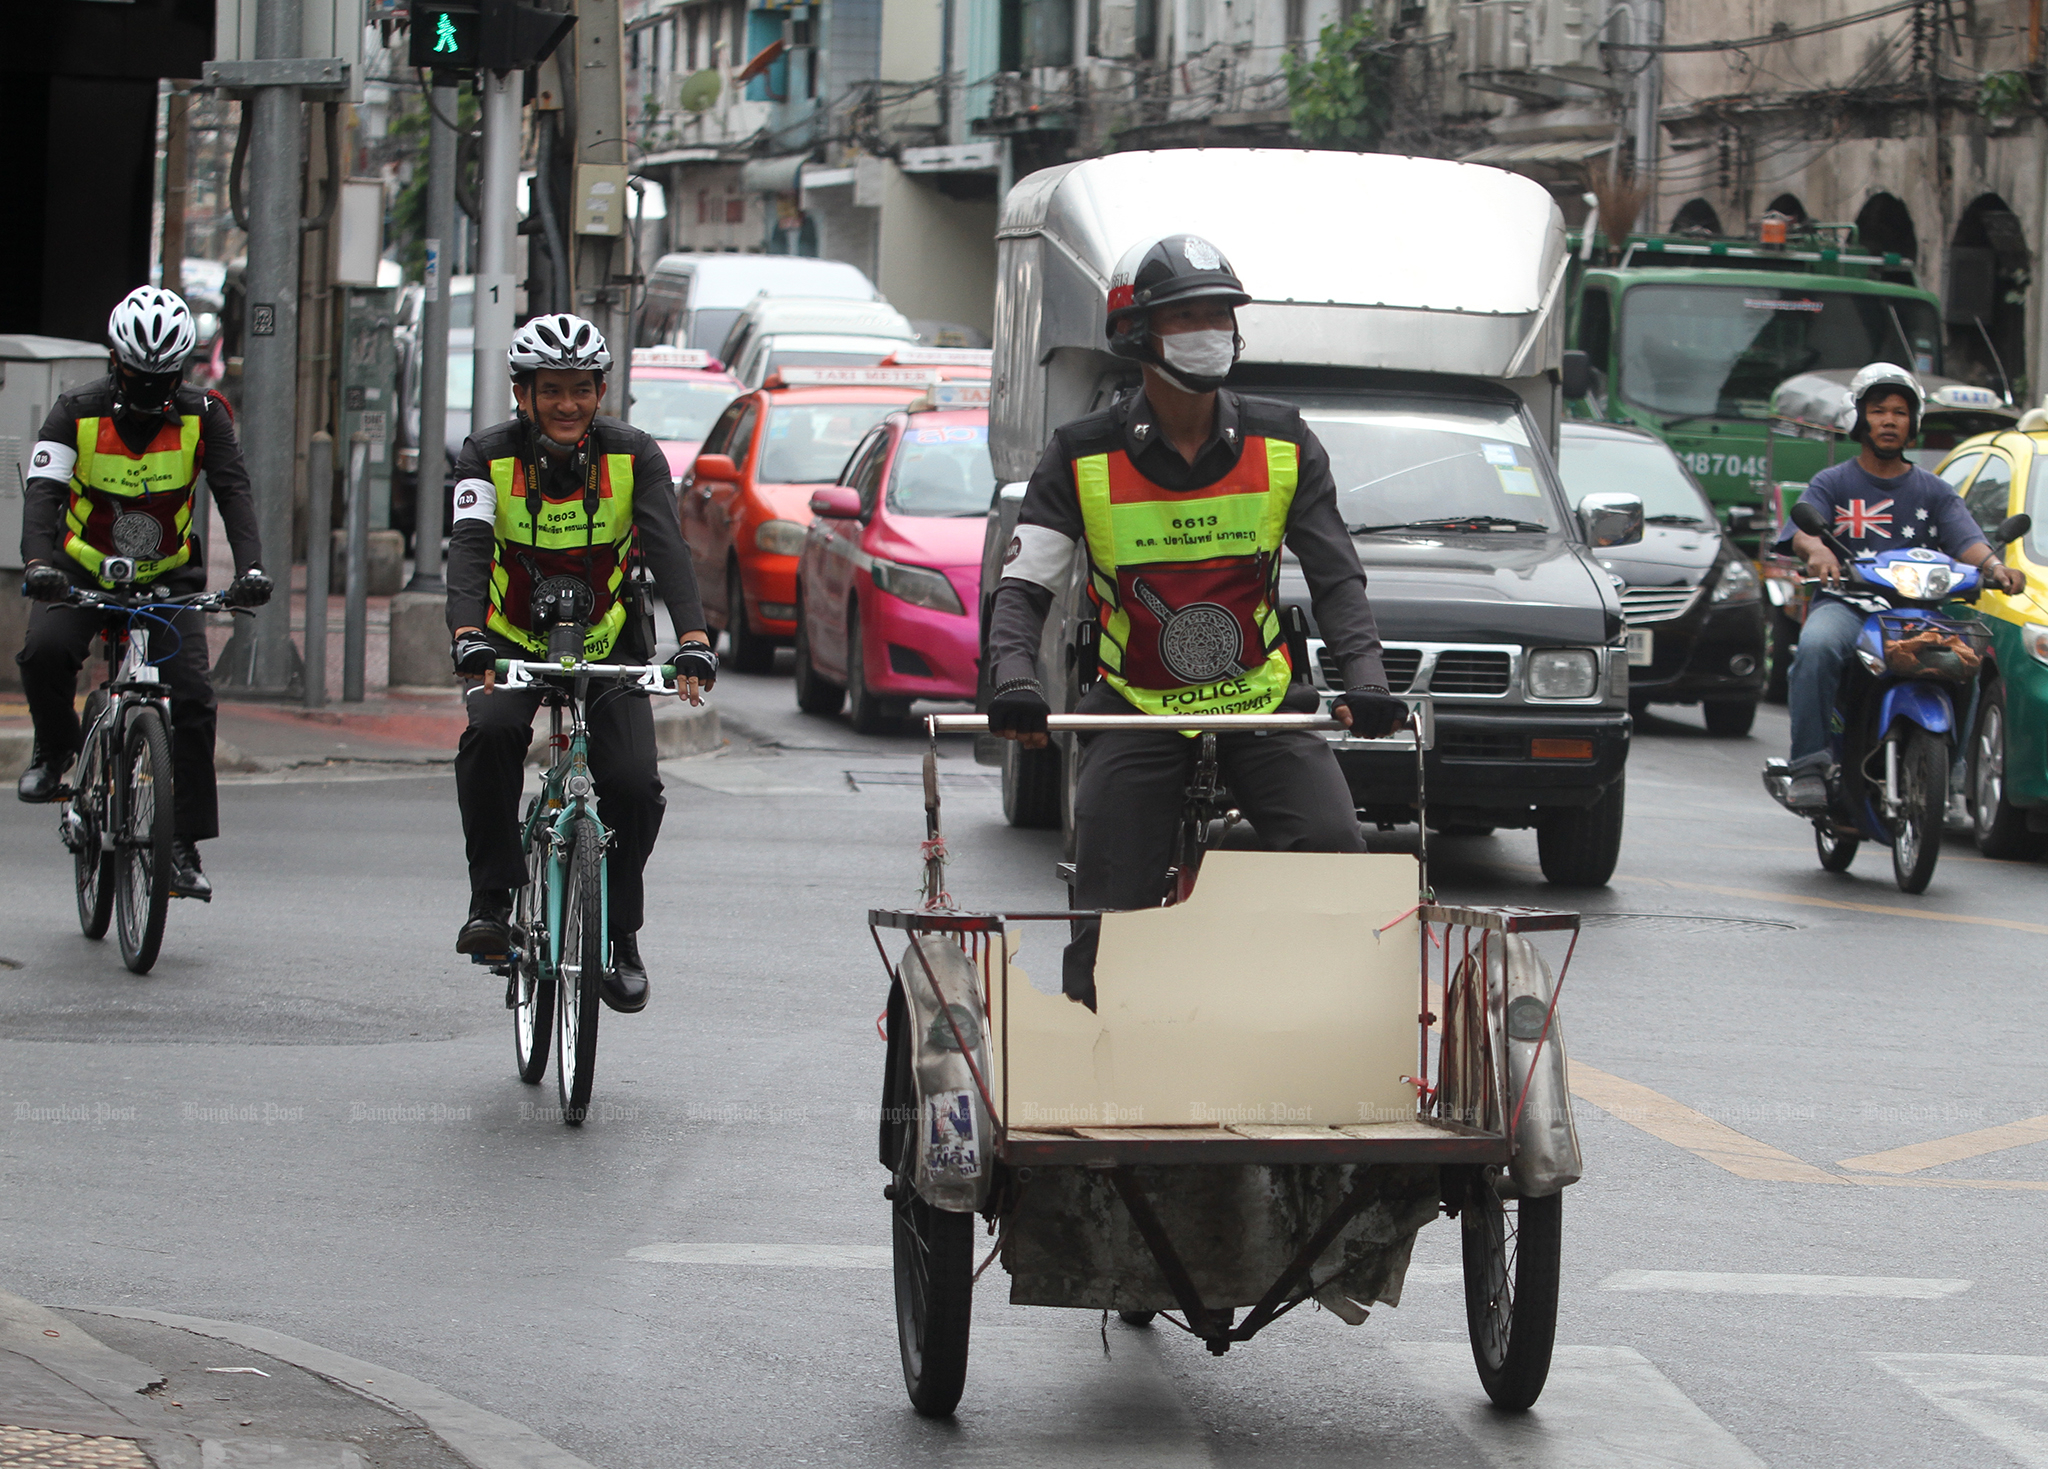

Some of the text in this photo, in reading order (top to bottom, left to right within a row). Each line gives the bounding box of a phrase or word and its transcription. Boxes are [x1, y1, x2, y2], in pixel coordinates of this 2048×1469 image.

[490, 284, 500, 304] 1
[815, 371, 926, 381] TAXI METER
[528, 464, 538, 490] Nikon
[588, 464, 598, 491] Nikon
[1172, 515, 1218, 529] 6613
[1162, 678, 1251, 707] POLICE
